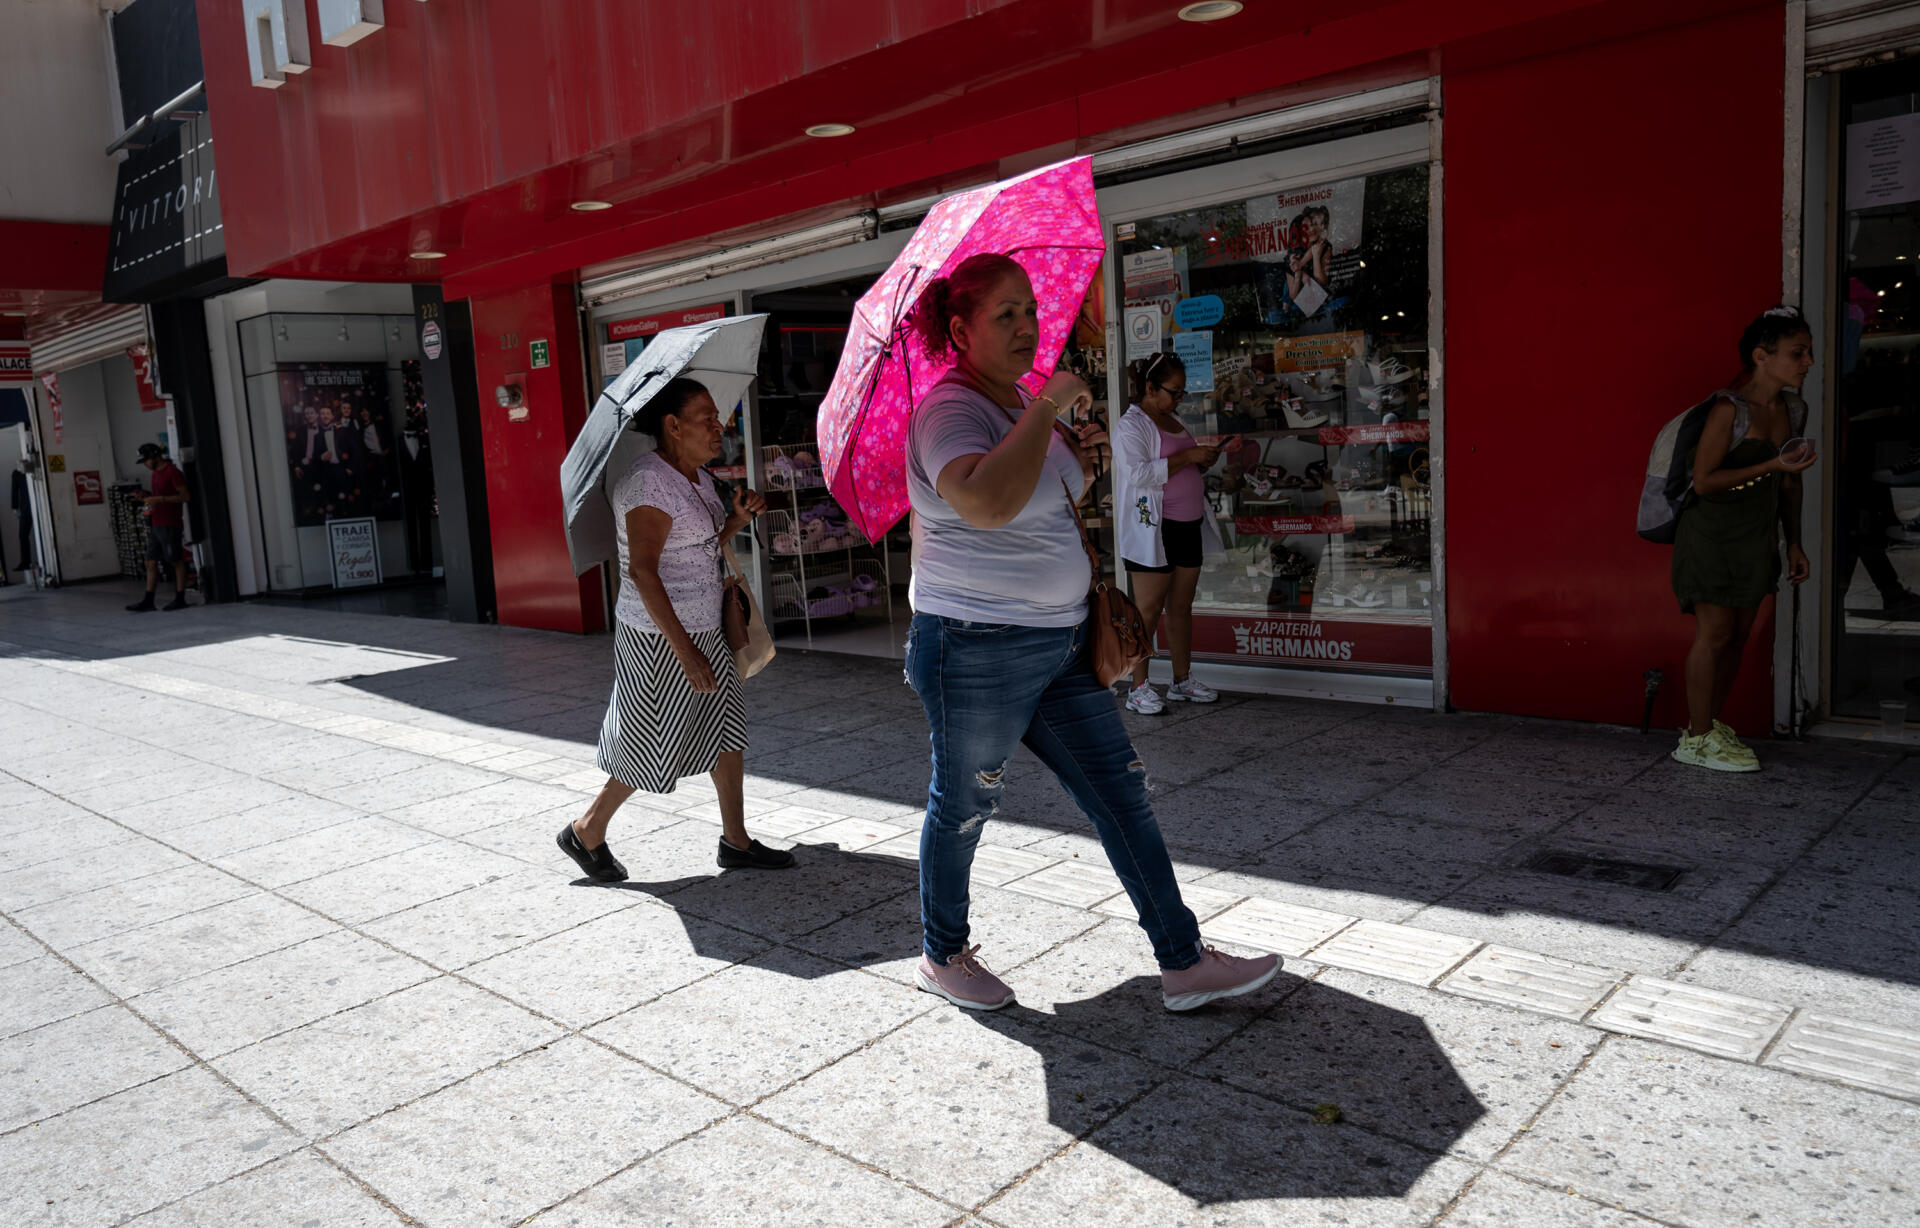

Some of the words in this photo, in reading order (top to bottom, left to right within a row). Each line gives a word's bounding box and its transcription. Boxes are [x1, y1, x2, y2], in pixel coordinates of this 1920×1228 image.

[129, 169, 215, 233] VITTORI
[334, 525, 370, 536] TRAJE
[1253, 621, 1322, 638] ZAPATERÍA
